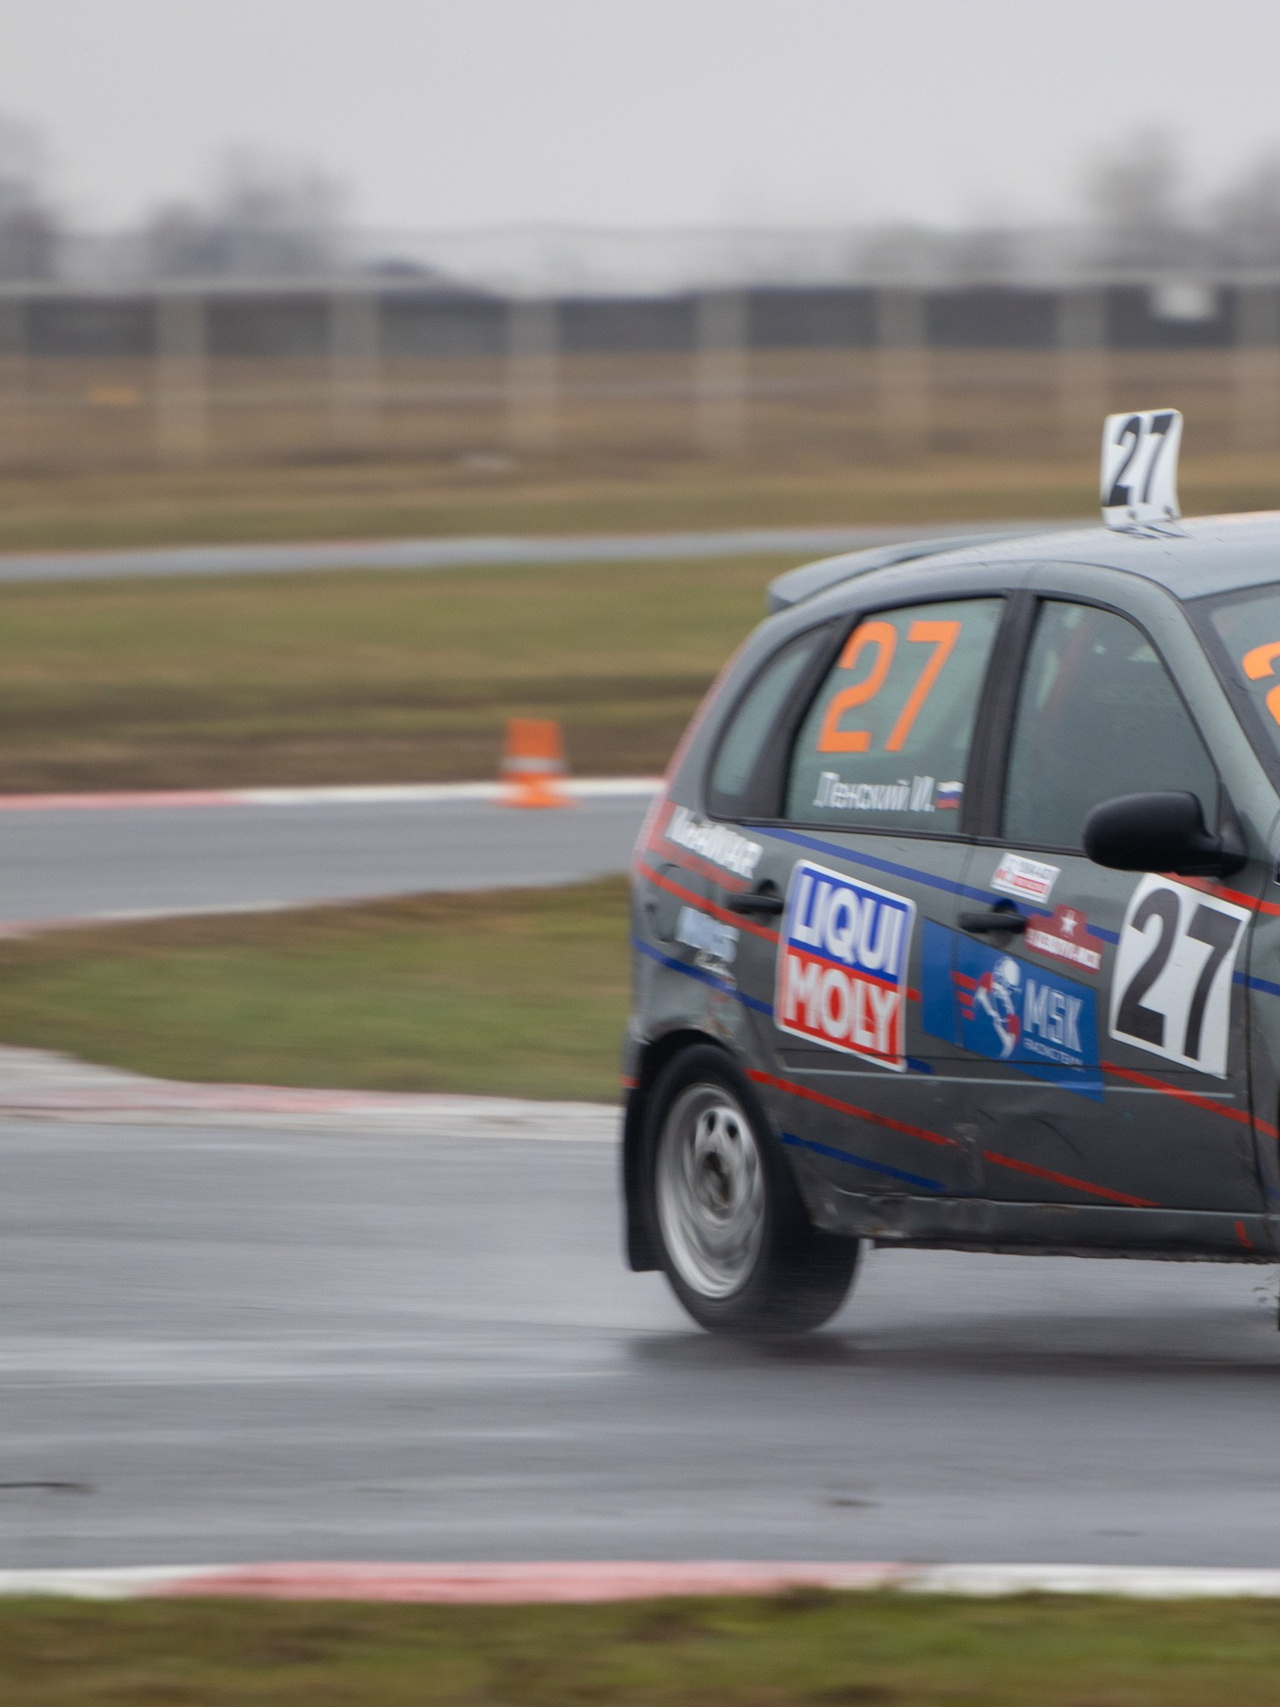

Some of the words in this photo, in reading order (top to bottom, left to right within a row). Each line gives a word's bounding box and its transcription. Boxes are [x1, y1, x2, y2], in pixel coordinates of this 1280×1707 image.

[1107, 413, 1175, 507] 27
[816, 620, 962, 754] 27
[812, 771, 911, 812] Ленский
[909, 775, 936, 813] И.
[793, 873, 905, 976] LIQUI
[1115, 887, 1242, 1061] 27
[783, 953, 902, 1055] MOLY
[1023, 979, 1083, 1052] MSK
